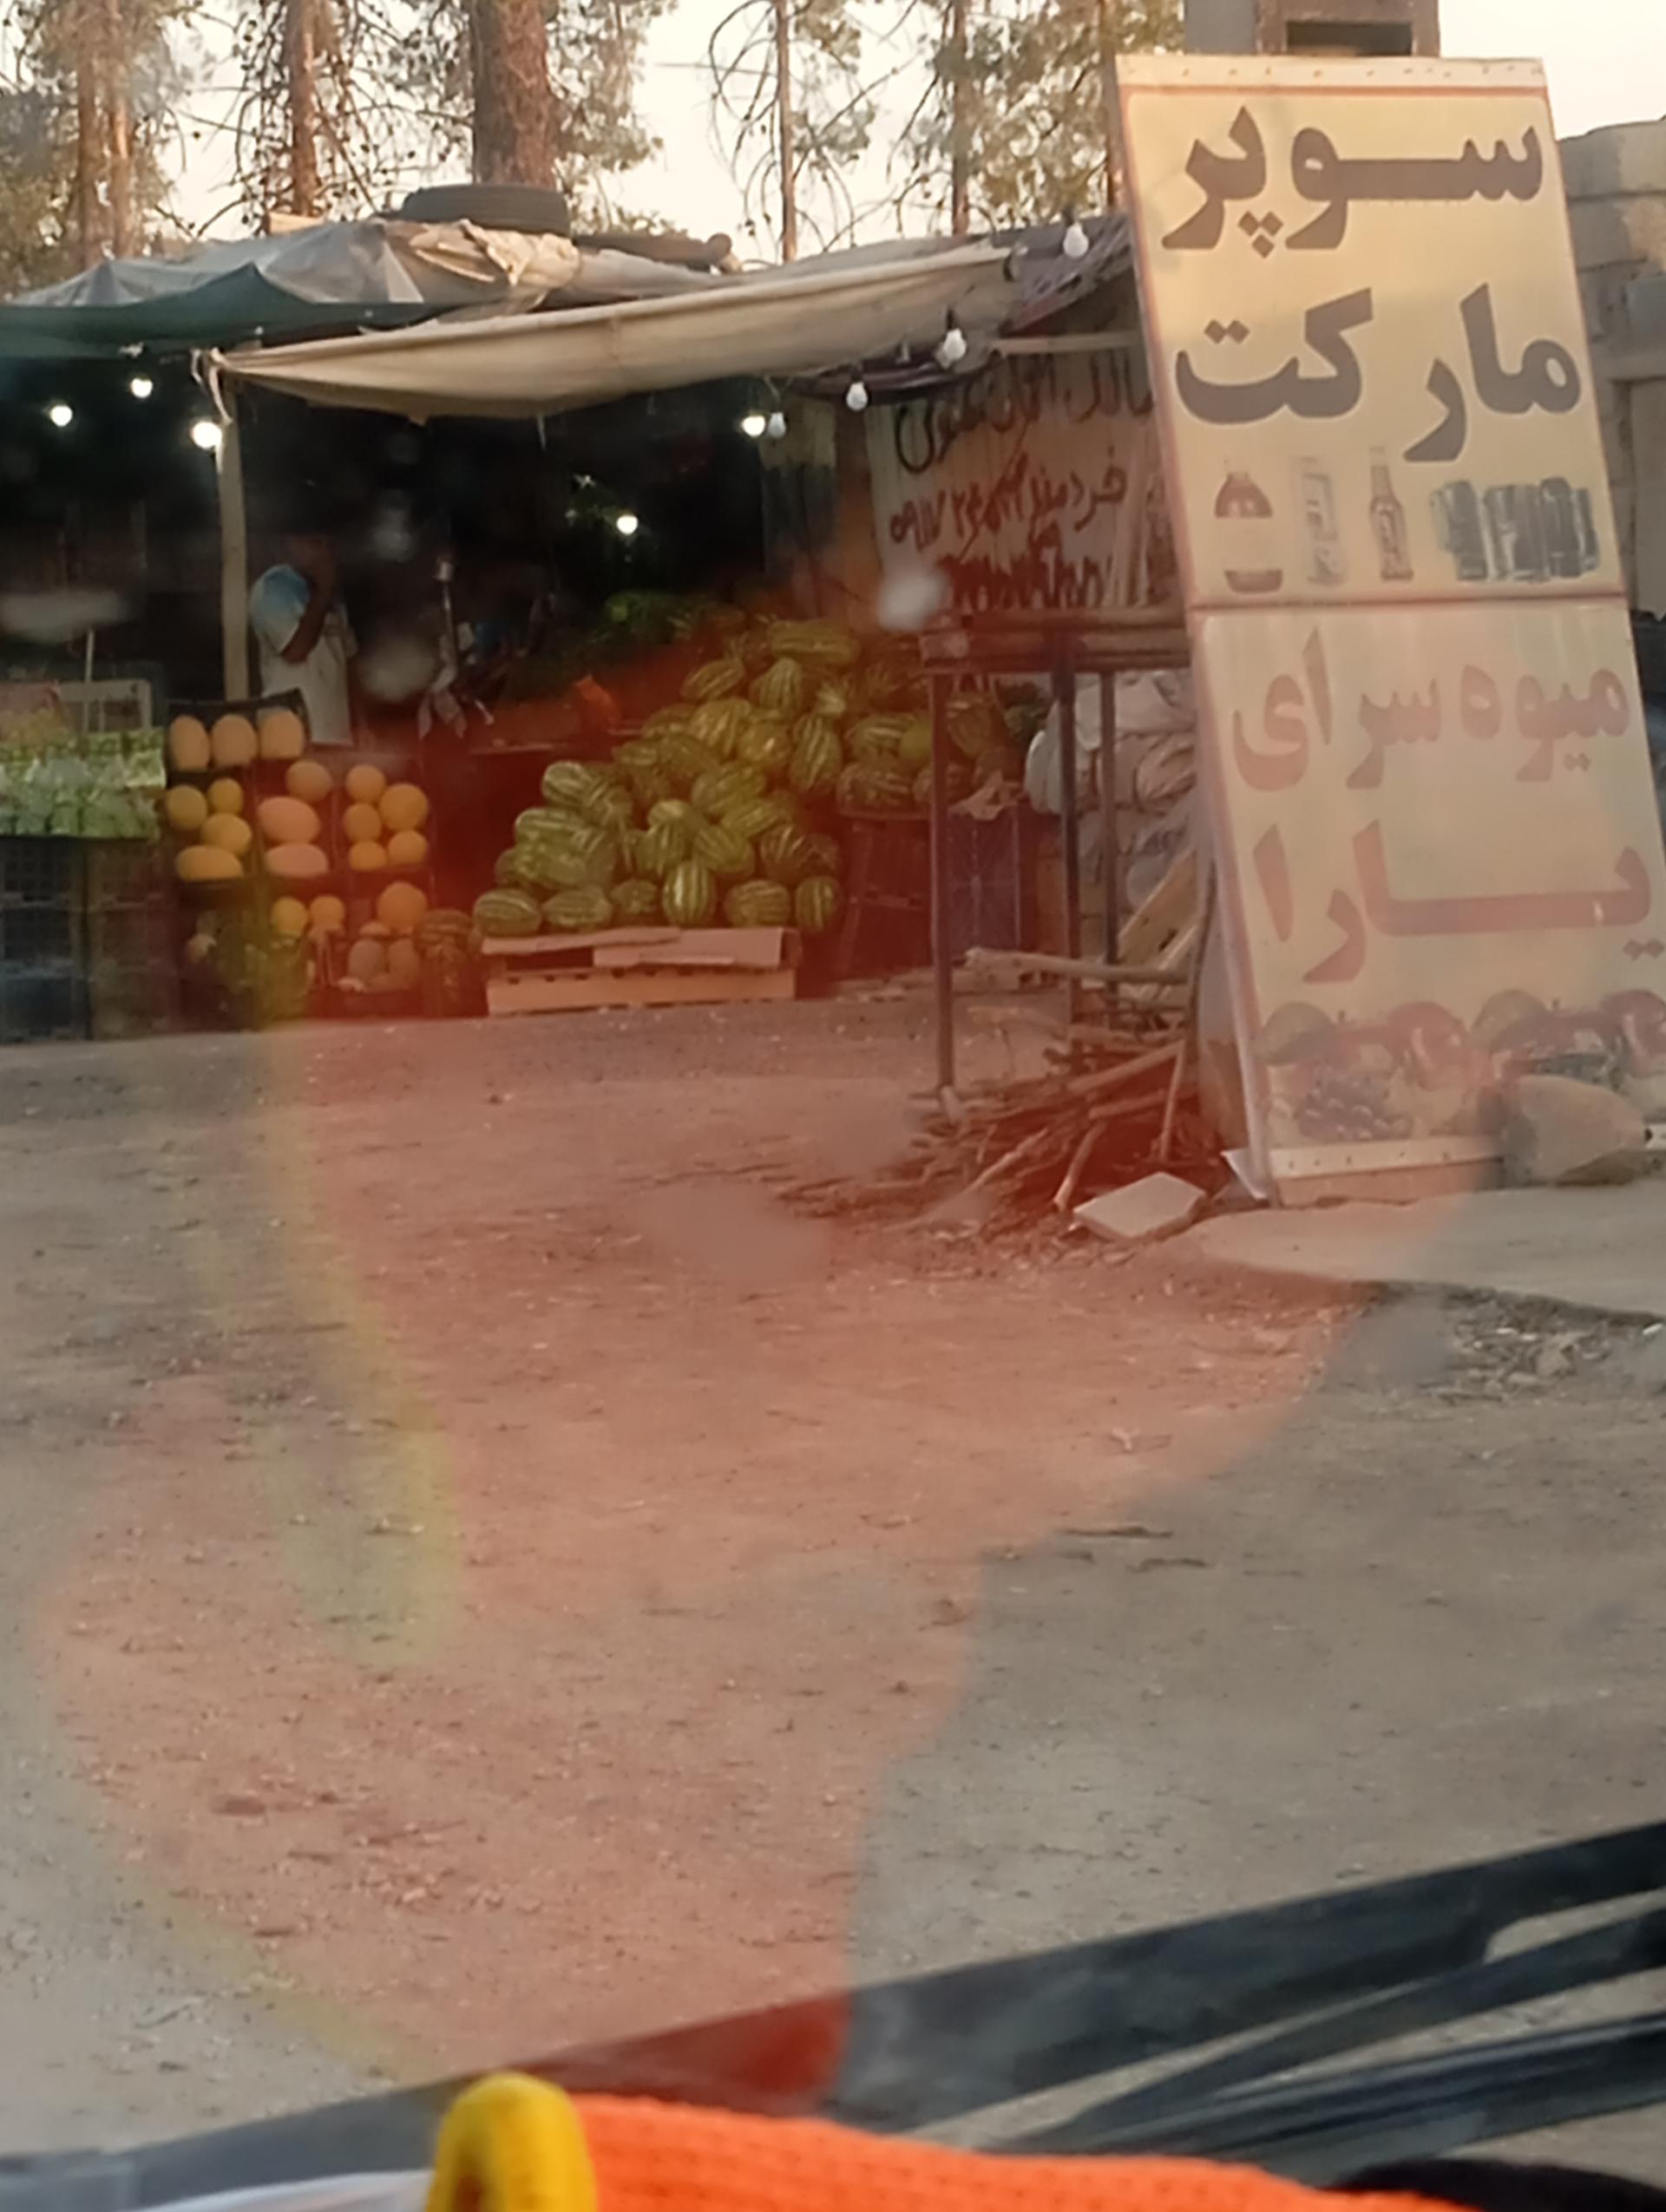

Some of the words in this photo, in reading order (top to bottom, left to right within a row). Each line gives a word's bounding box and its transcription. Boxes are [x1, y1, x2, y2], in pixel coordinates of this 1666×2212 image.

[1162, 105, 1544, 259] سوپر
[1176, 282, 1582, 462] مارکت
[1252, 818, 1664, 984] یارا
